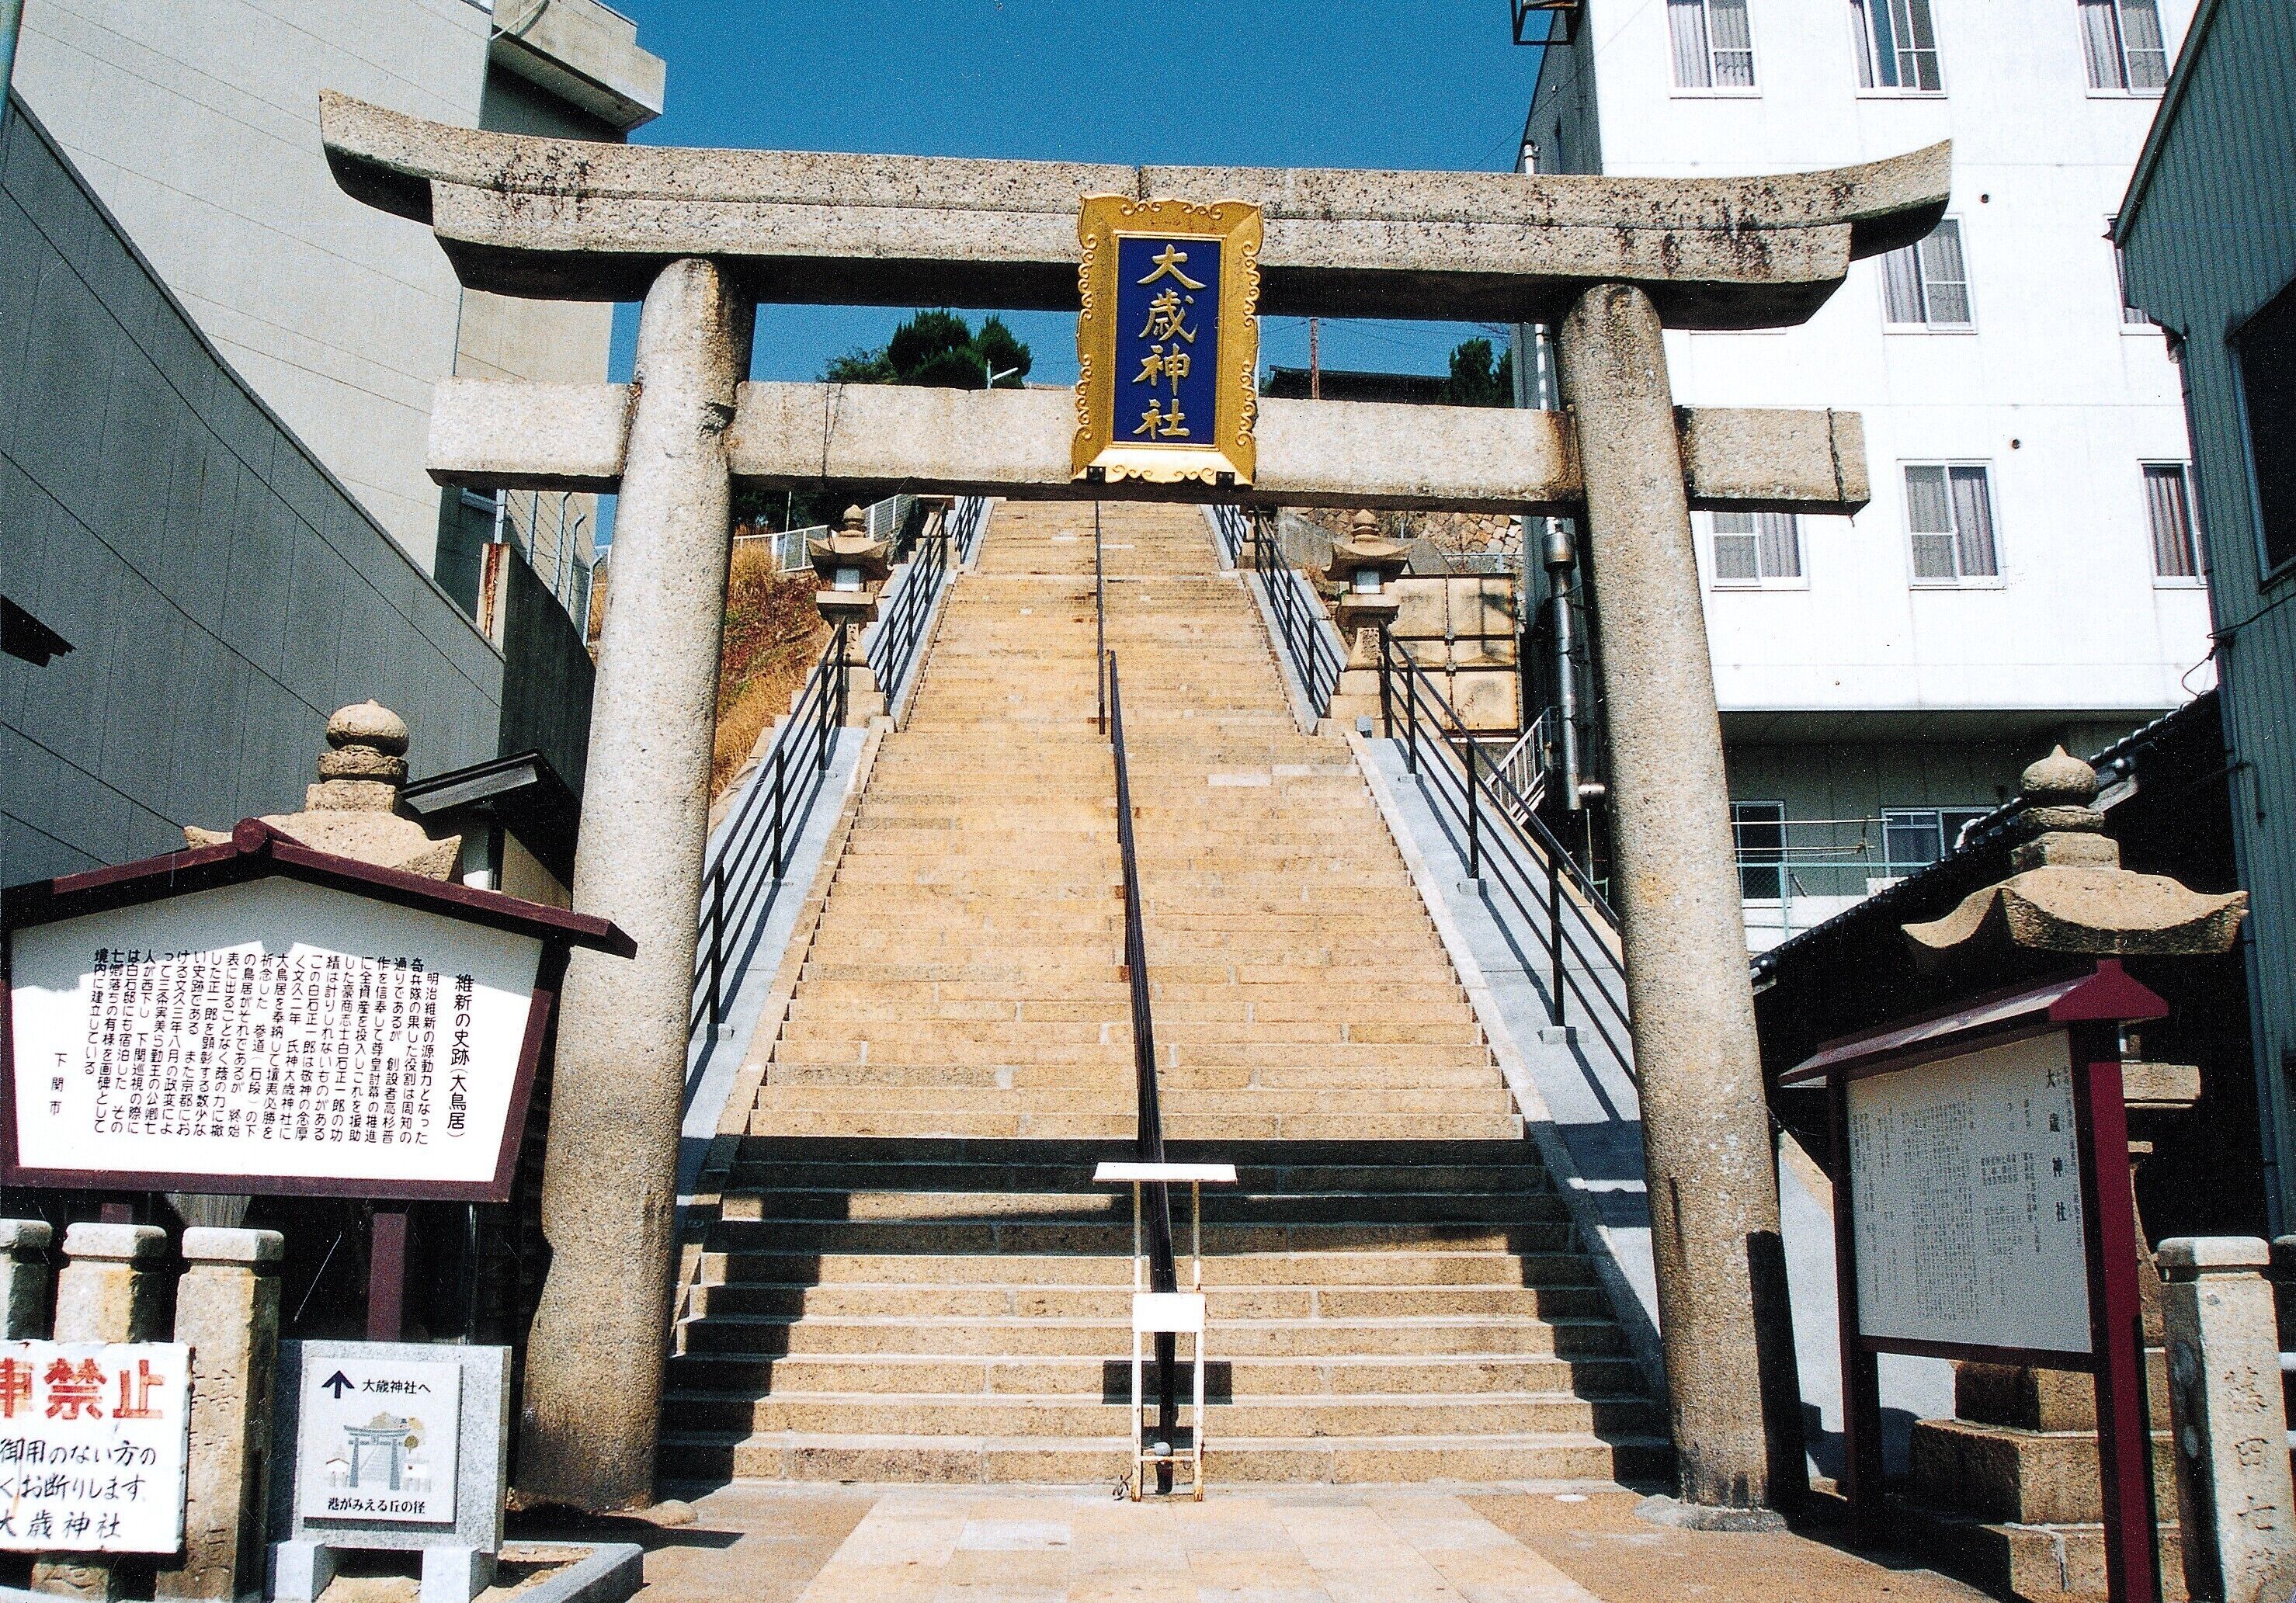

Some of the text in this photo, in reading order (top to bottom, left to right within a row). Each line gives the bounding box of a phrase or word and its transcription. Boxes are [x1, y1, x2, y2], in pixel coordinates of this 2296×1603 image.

[1132, 244, 1207, 440] 大歳神社
[50, 1053, 67, 1115] 下関市
[362, 1379, 431, 1394] 大歳神社へ
[0, 1437, 156, 1466] 御用のない方の
[328, 1497, 426, 1514] 港がみえる丘の径
[0, 1509, 122, 1539] 大歳神社
